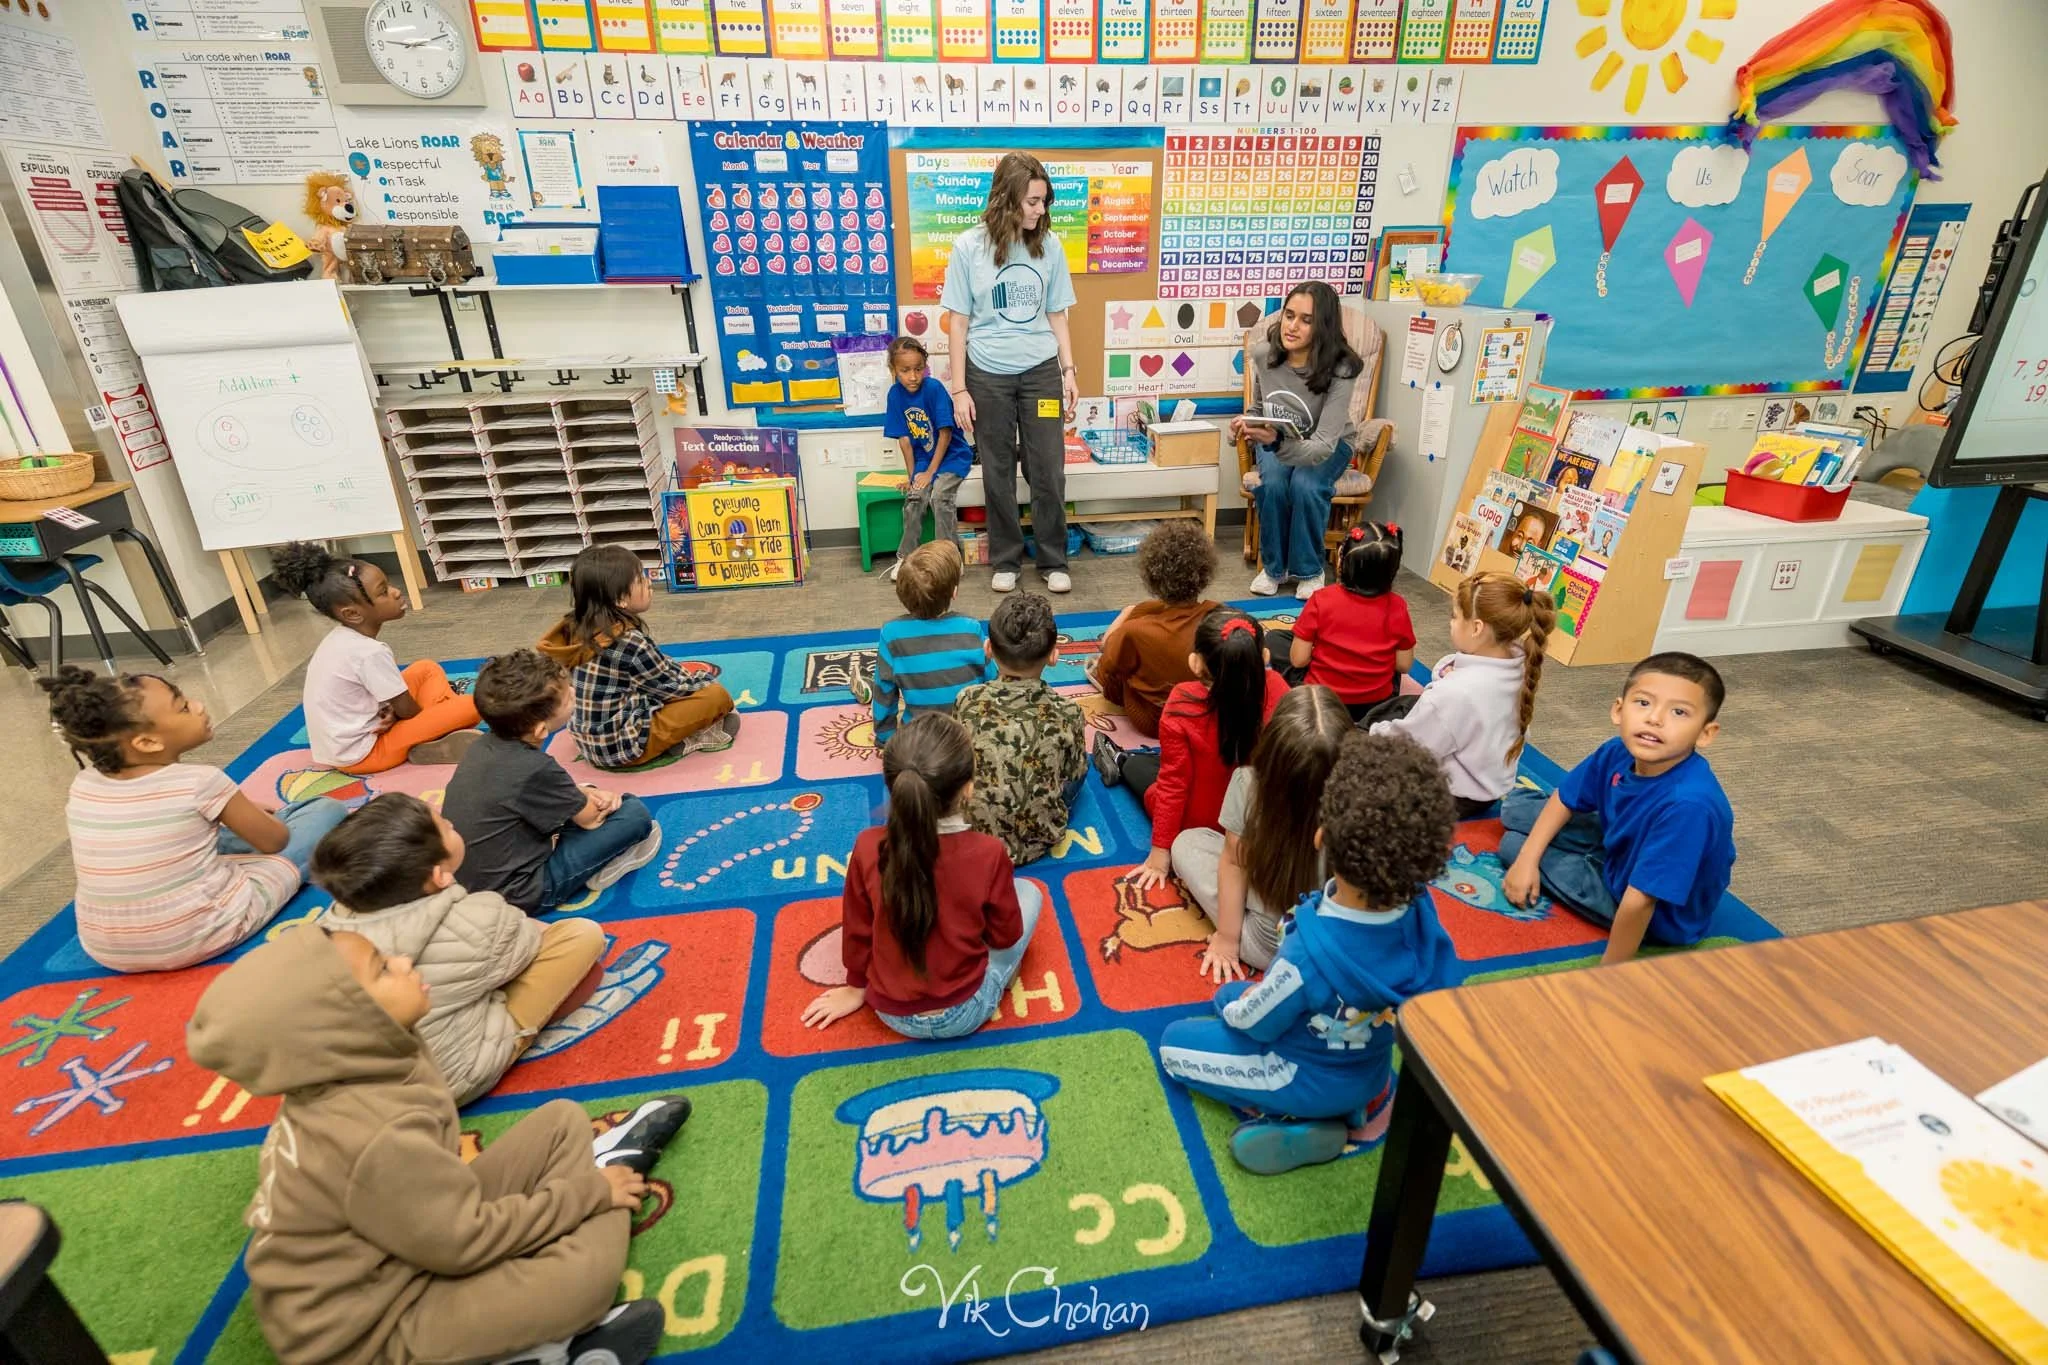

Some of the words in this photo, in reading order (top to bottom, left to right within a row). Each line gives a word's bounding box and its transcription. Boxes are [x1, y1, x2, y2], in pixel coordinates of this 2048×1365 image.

[401, 1, 413, 13] 12
[729, 0, 747, 8] five
[790, 1, 802, 10] six
[841, 3, 864, 12] seven
[898, 2, 920, 14] eight
[955, 4, 973, 14] nine
[1011, 5, 1024, 14] ten
[386, 8, 396, 18] 11
[423, 6, 428, 19] 1
[1058, 6, 1085, 15] eleven
[1110, 7, 1137, 16] twelve
[1160, 6, 1193, 16] thirteen
[1210, 7, 1245, 17] fourteen
[1266, 7, 1291, 17] fifteen
[1315, 7, 1343, 17] sixteen
[1359, 8, 1396, 17] seventeen
[1411, 8, 1443, 19] eighteen
[1459, 9, 1491, 18] nineteen
[1509, 10, 1535, 20] twenty
[132, 12, 149, 32] R
[376, 20, 387, 32] 10
[437, 21, 446, 33] 2
[377, 40, 385, 51] 9
[447, 40, 455, 51] 3
[183, 52, 205, 62] Lion
[207, 52, 231, 62] code
[234, 52, 259, 62] when
[265, 52, 291, 62] ROAR
[387, 58, 395, 70] 8
[447, 58, 455, 70] 4
[138, 70, 157, 89] R
[402, 72, 409, 83] 7
[420, 77, 428, 89] 6
[436, 72, 444, 83] 5
[150, 102, 168, 119] O
[1237, 127, 1286, 135] NUMBERS
[162, 131, 179, 148] A
[346, 136, 380, 150] Lake
[383, 137, 419, 150] Lions
[420, 135, 461, 148] ROAR
[714, 132, 783, 149] Calendar
[785, 131, 799, 149] &
[801, 132, 864, 150] Weather
[1173, 138, 1179, 150] 1
[1195, 138, 1204, 150] 2
[1217, 138, 1226, 150] 3
[1239, 138, 1248, 150] 4
[1261, 138, 1270, 150] 5
[1283, 138, 1292, 150] 6
[1306, 138, 1314, 150] 7
[1326, 138, 1335, 150] 8
[1348, 138, 1357, 150] 9
[1367, 138, 1380, 150] 10
[169, 159, 187, 177] R
[374, 157, 441, 172] Respectful
[723, 162, 749, 170] Month
[802, 161, 820, 171] Year
[917, 155, 950, 170] Days
[20, 162, 71, 176] EXPULSION
[1111, 163, 1139, 175] Year
[1487, 156, 1539, 197] Watch
[1696, 166, 1713, 188] Us
[1846, 161, 1882, 189] Soar
[378, 176, 396, 187] On
[397, 176, 426, 187] Task
[937, 175, 981, 189] Sunday
[384, 192, 460, 204] Accountable
[935, 194, 984, 208] Monday
[1103, 196, 1135, 207] August
[387, 208, 459, 222] Responsible
[1103, 213, 1149, 224] September
[1103, 230, 1137, 239] October
[1103, 245, 1145, 254] November
[1102, 260, 1144, 269] December
[1007, 285, 1036, 293] LEADERS
[1008, 292, 1038, 300] READERS
[767, 304, 803, 313] Yesterday
[813, 303, 849, 311] Tomorrow
[863, 302, 890, 311] Season
[1008, 300, 1040, 308] NETWORK
[726, 306, 750, 315] Today
[1174, 334, 1194, 344] Oval
[782, 341, 808, 350] Today's
[218, 376, 278, 394] Addition
[1106, 384, 1133, 392] Square
[1138, 383, 1164, 392] Heart
[771, 433, 779, 444] K
[788, 435, 795, 445] K
[682, 442, 705, 452] Text
[708, 441, 760, 452] Collection
[1557, 452, 1569, 462] WE
[1568, 456, 1581, 466] ARE
[1580, 459, 1597, 471] HERE
[313, 481, 326, 494] in
[338, 476, 355, 490] all
[227, 492, 261, 511] join
[713, 496, 760, 517] Everyone
[1478, 504, 1503, 528] Cupig
[755, 515, 782, 534] learn
[708, 541, 723, 557] to
[760, 537, 782, 555] ride
[709, 562, 717, 577] a
[721, 561, 760, 582] bicycle
[1068, 1182, 1187, 1257] Cc
